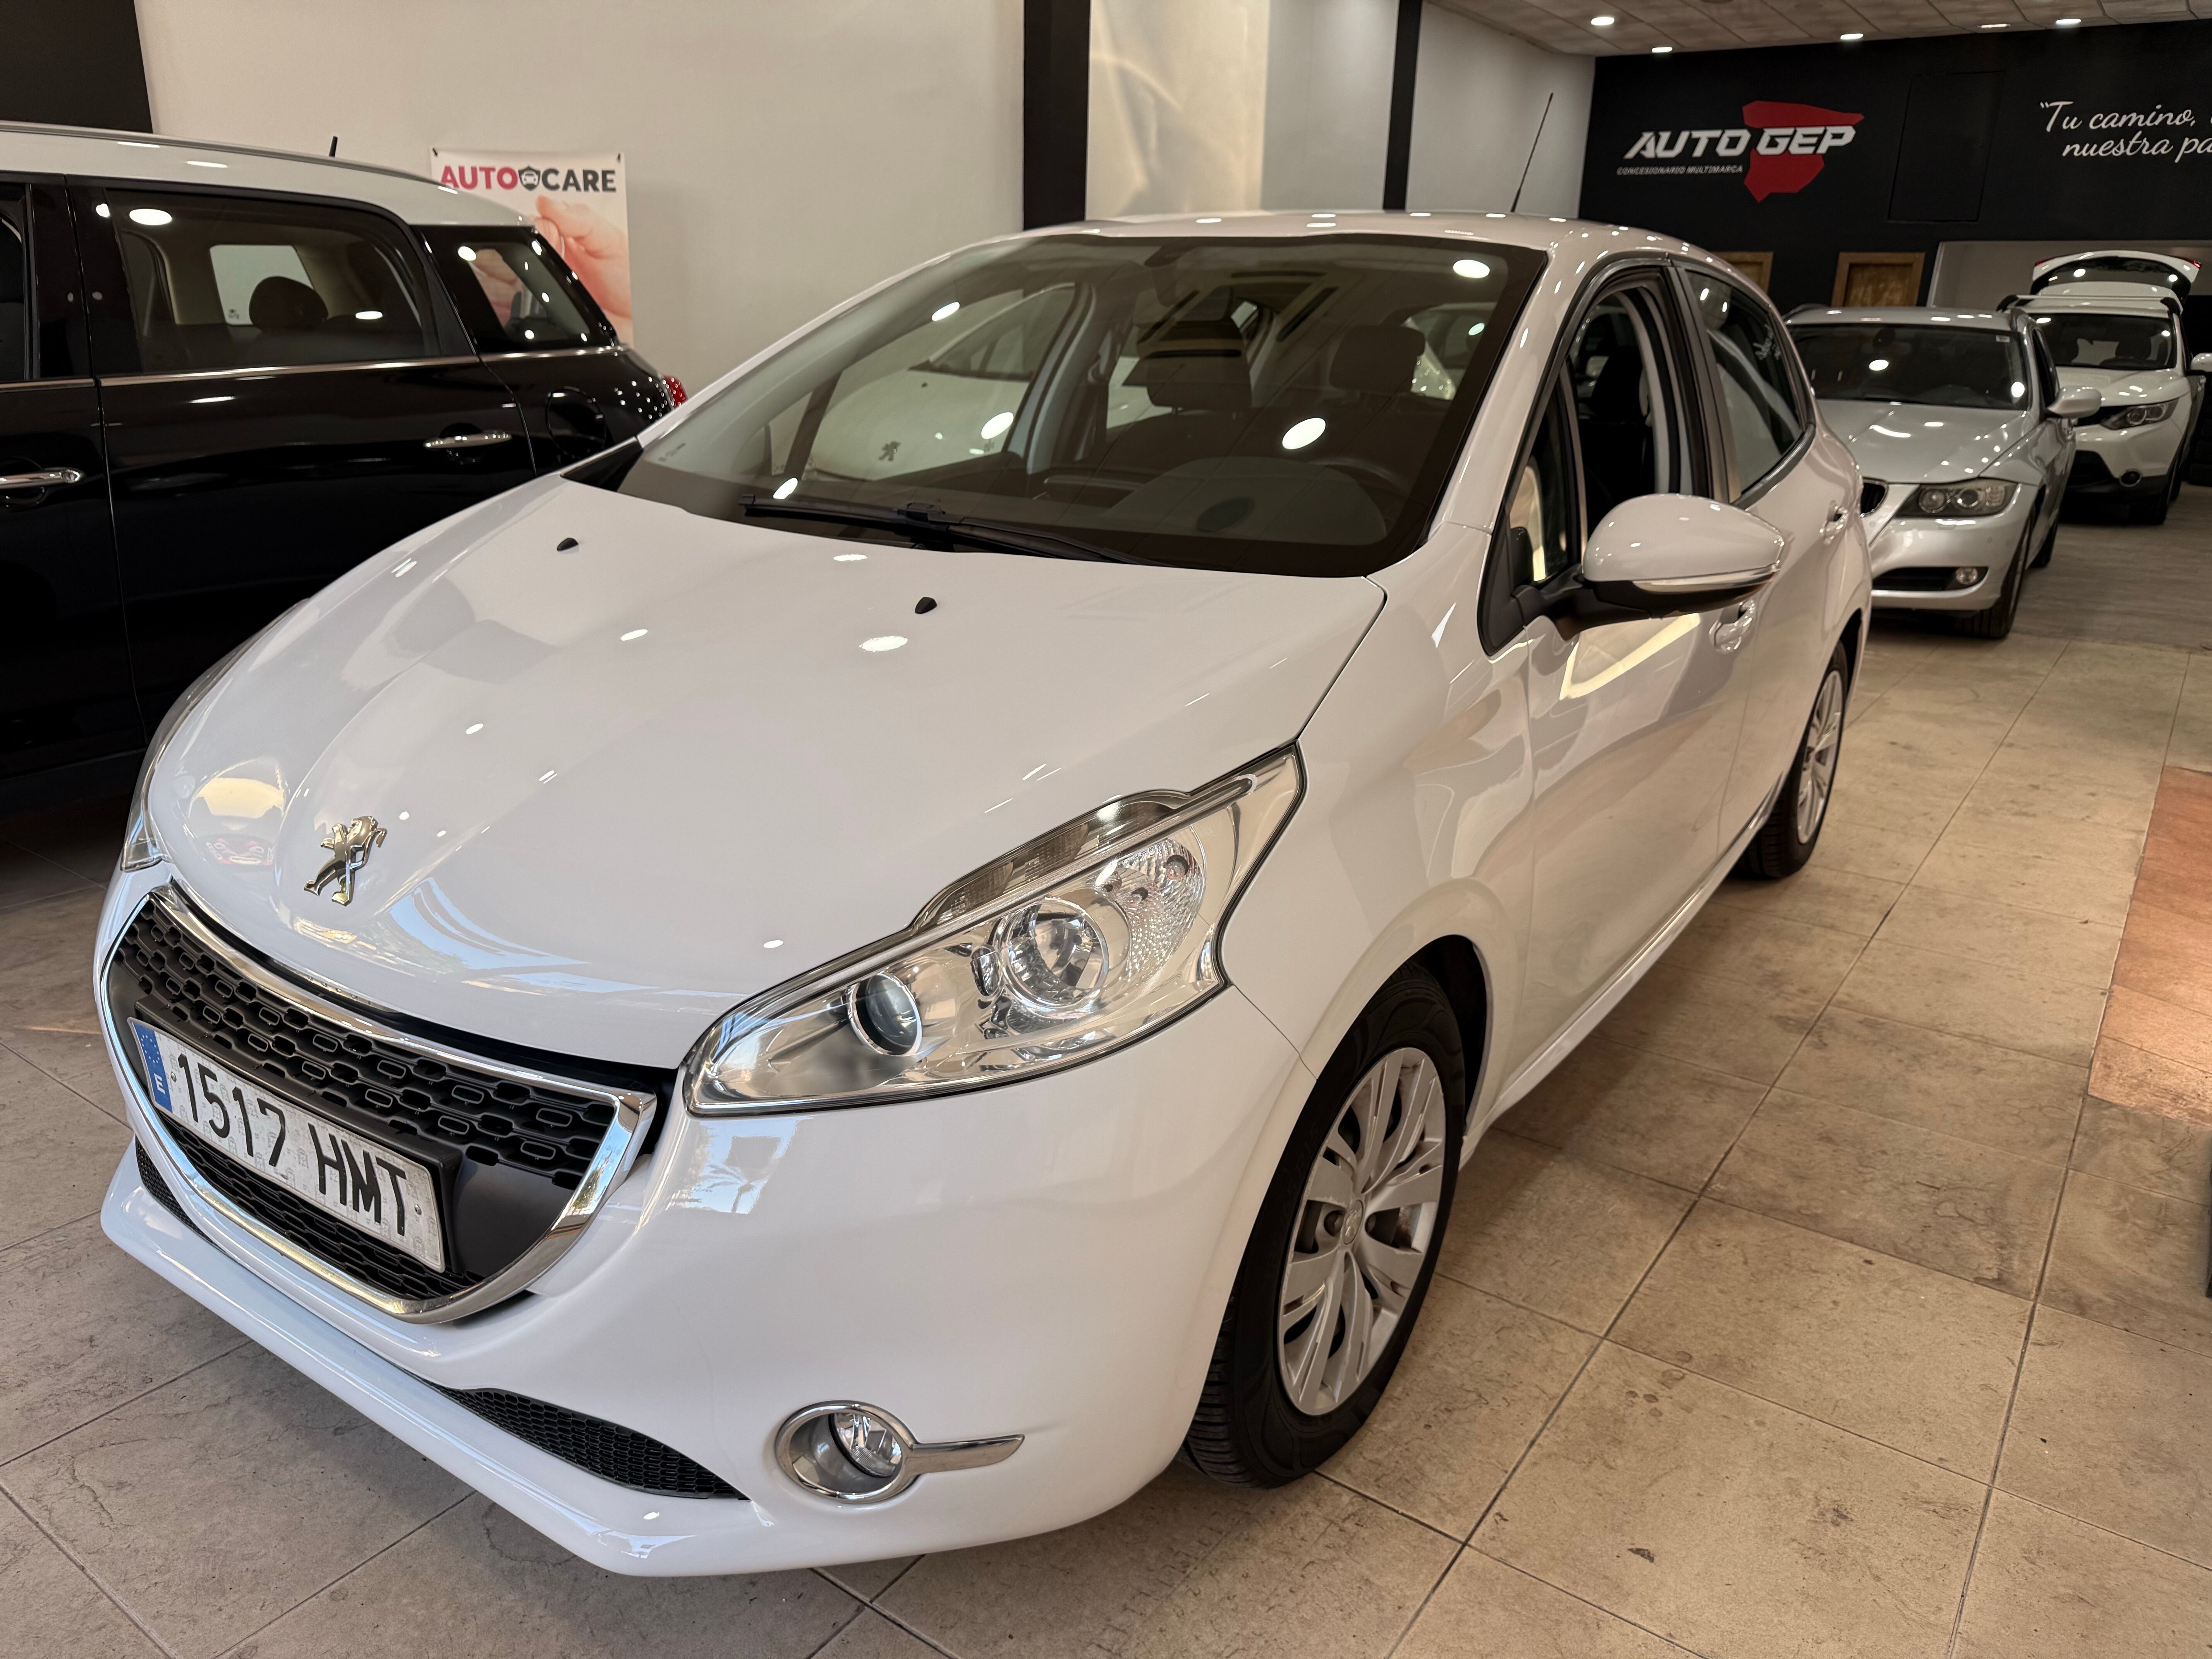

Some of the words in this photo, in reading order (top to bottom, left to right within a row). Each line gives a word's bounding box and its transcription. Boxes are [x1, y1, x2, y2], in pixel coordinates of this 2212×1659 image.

[2089, 104, 2196, 129] camino,
[1624, 128, 1751, 159] AUTO
[1756, 125, 1856, 156] GEP
[2062, 131, 2174, 157] nuestra
[441, 165, 519, 190] AUTO
[542, 168, 617, 192] CARE
[1616, 166, 1686, 175] CONCESIONARIO
[1686, 164, 1743, 174] MULTIMARCA
[155, 1075, 166, 1094] E
[177, 1053, 286, 1167] 1517
[308, 1123, 407, 1236] HMT
